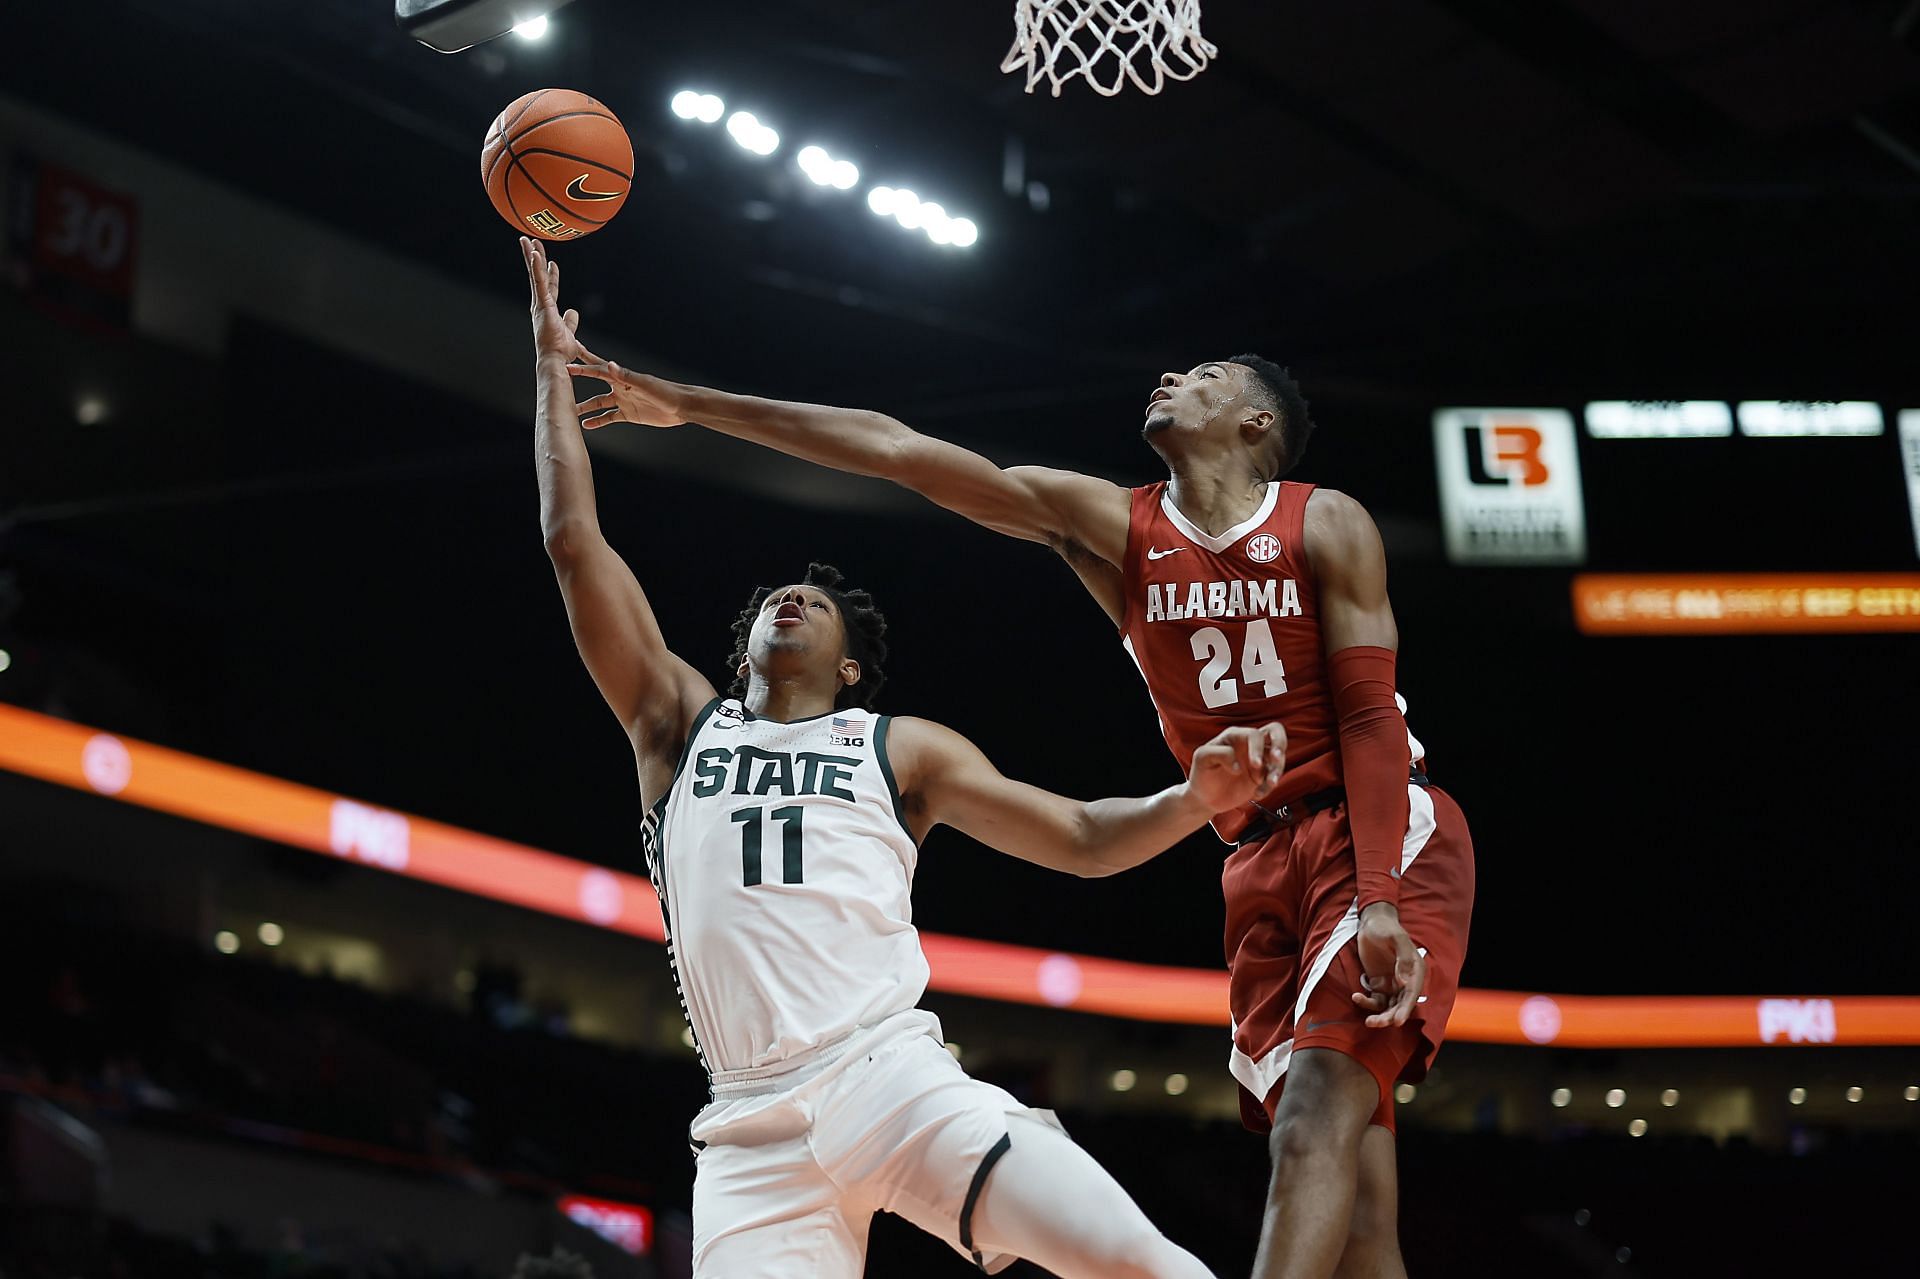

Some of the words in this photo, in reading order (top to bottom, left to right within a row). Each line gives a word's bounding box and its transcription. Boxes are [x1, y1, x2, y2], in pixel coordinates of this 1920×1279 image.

[47, 187, 127, 270] 30
[1249, 535, 1278, 561] SEC
[1146, 579, 1303, 622] ALABAMA
[1190, 618, 1288, 709] 24
[692, 744, 864, 803] STATE
[730, 806, 804, 887] 11
